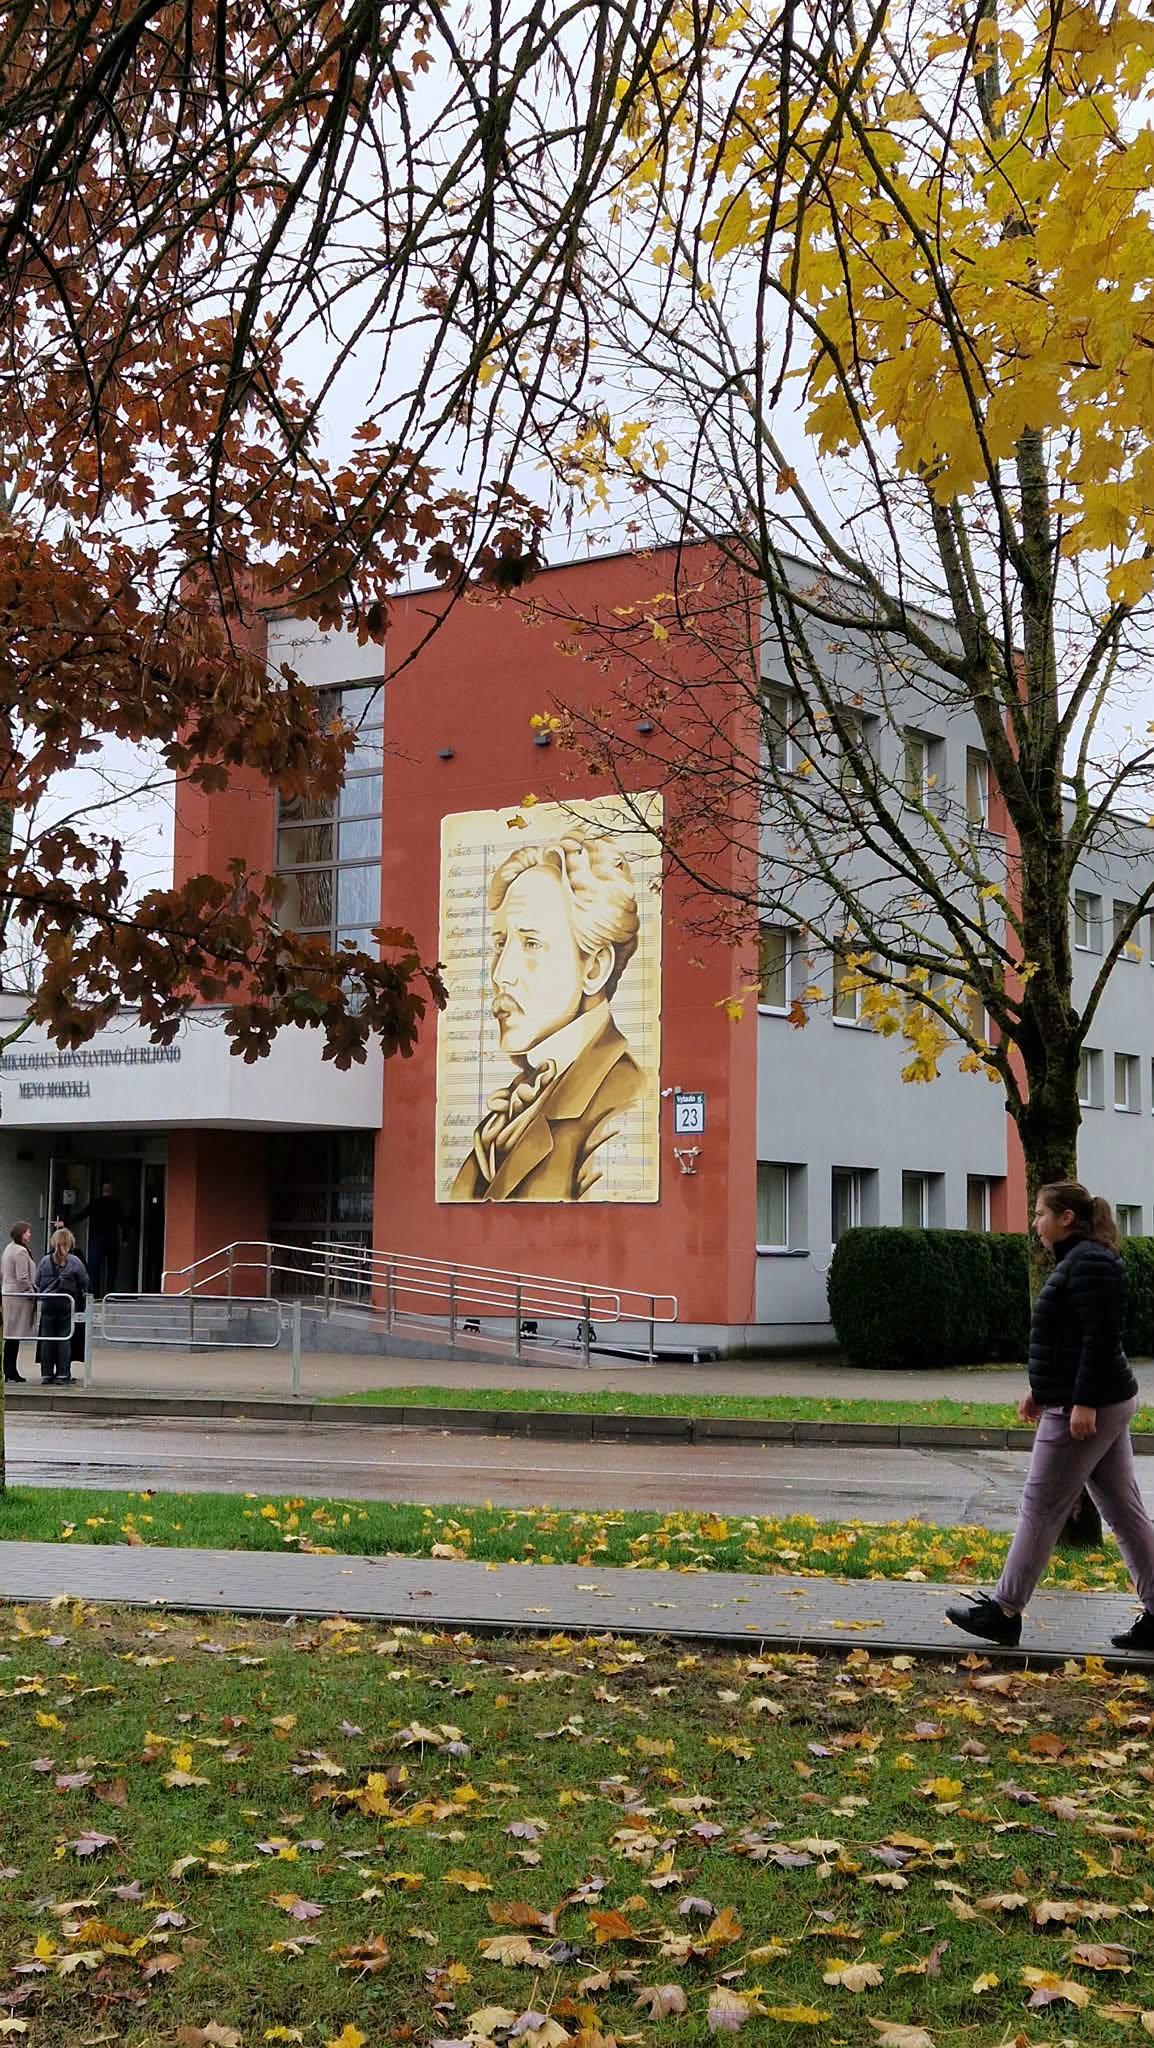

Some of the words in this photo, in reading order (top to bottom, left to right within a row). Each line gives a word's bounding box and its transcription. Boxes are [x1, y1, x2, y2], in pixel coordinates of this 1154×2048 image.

[58, 1048, 122, 1068] KONSTANTINO
[19, 1082, 45, 1099] MENO
[47, 1080, 91, 1098] MOKYKLA
[682, 1108, 698, 1127] 23
